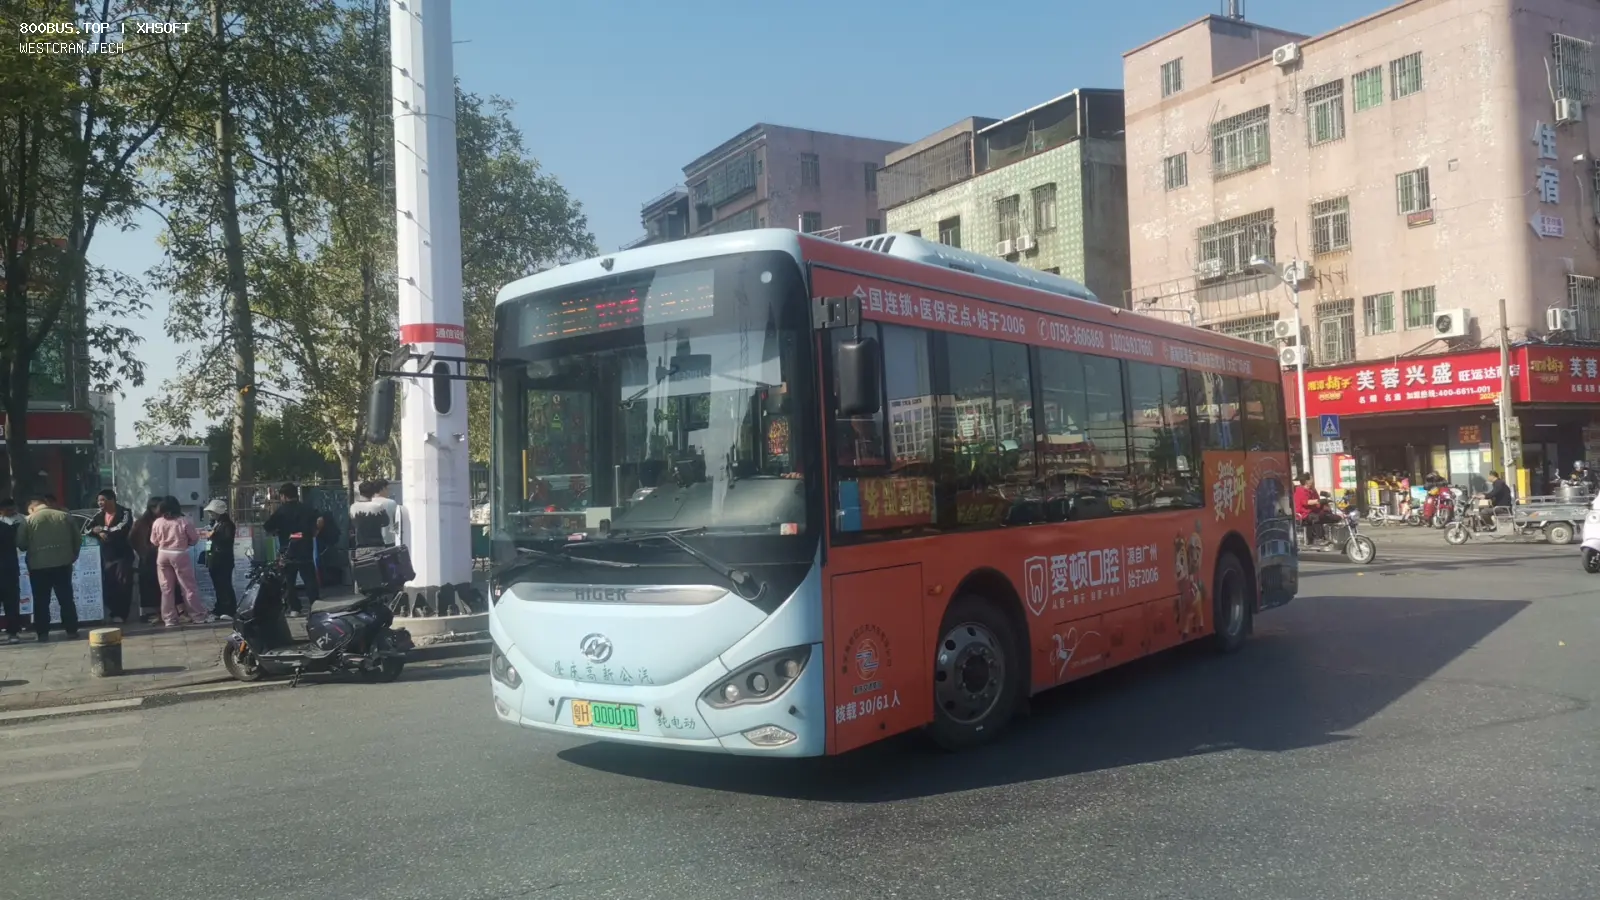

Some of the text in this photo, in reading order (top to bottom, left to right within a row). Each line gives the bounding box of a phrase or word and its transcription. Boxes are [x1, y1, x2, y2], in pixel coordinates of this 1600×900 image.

[1532, 120, 1559, 203] 住宿
[1356, 362, 1453, 391] 芙蓉兴盛
[575, 587, 627, 601] HIGER
[316, 632, 332, 649] FX
[859, 695, 889, 716] 30/61
[891, 689, 901, 708] 人
[657, 715, 696, 730] 纯电动
